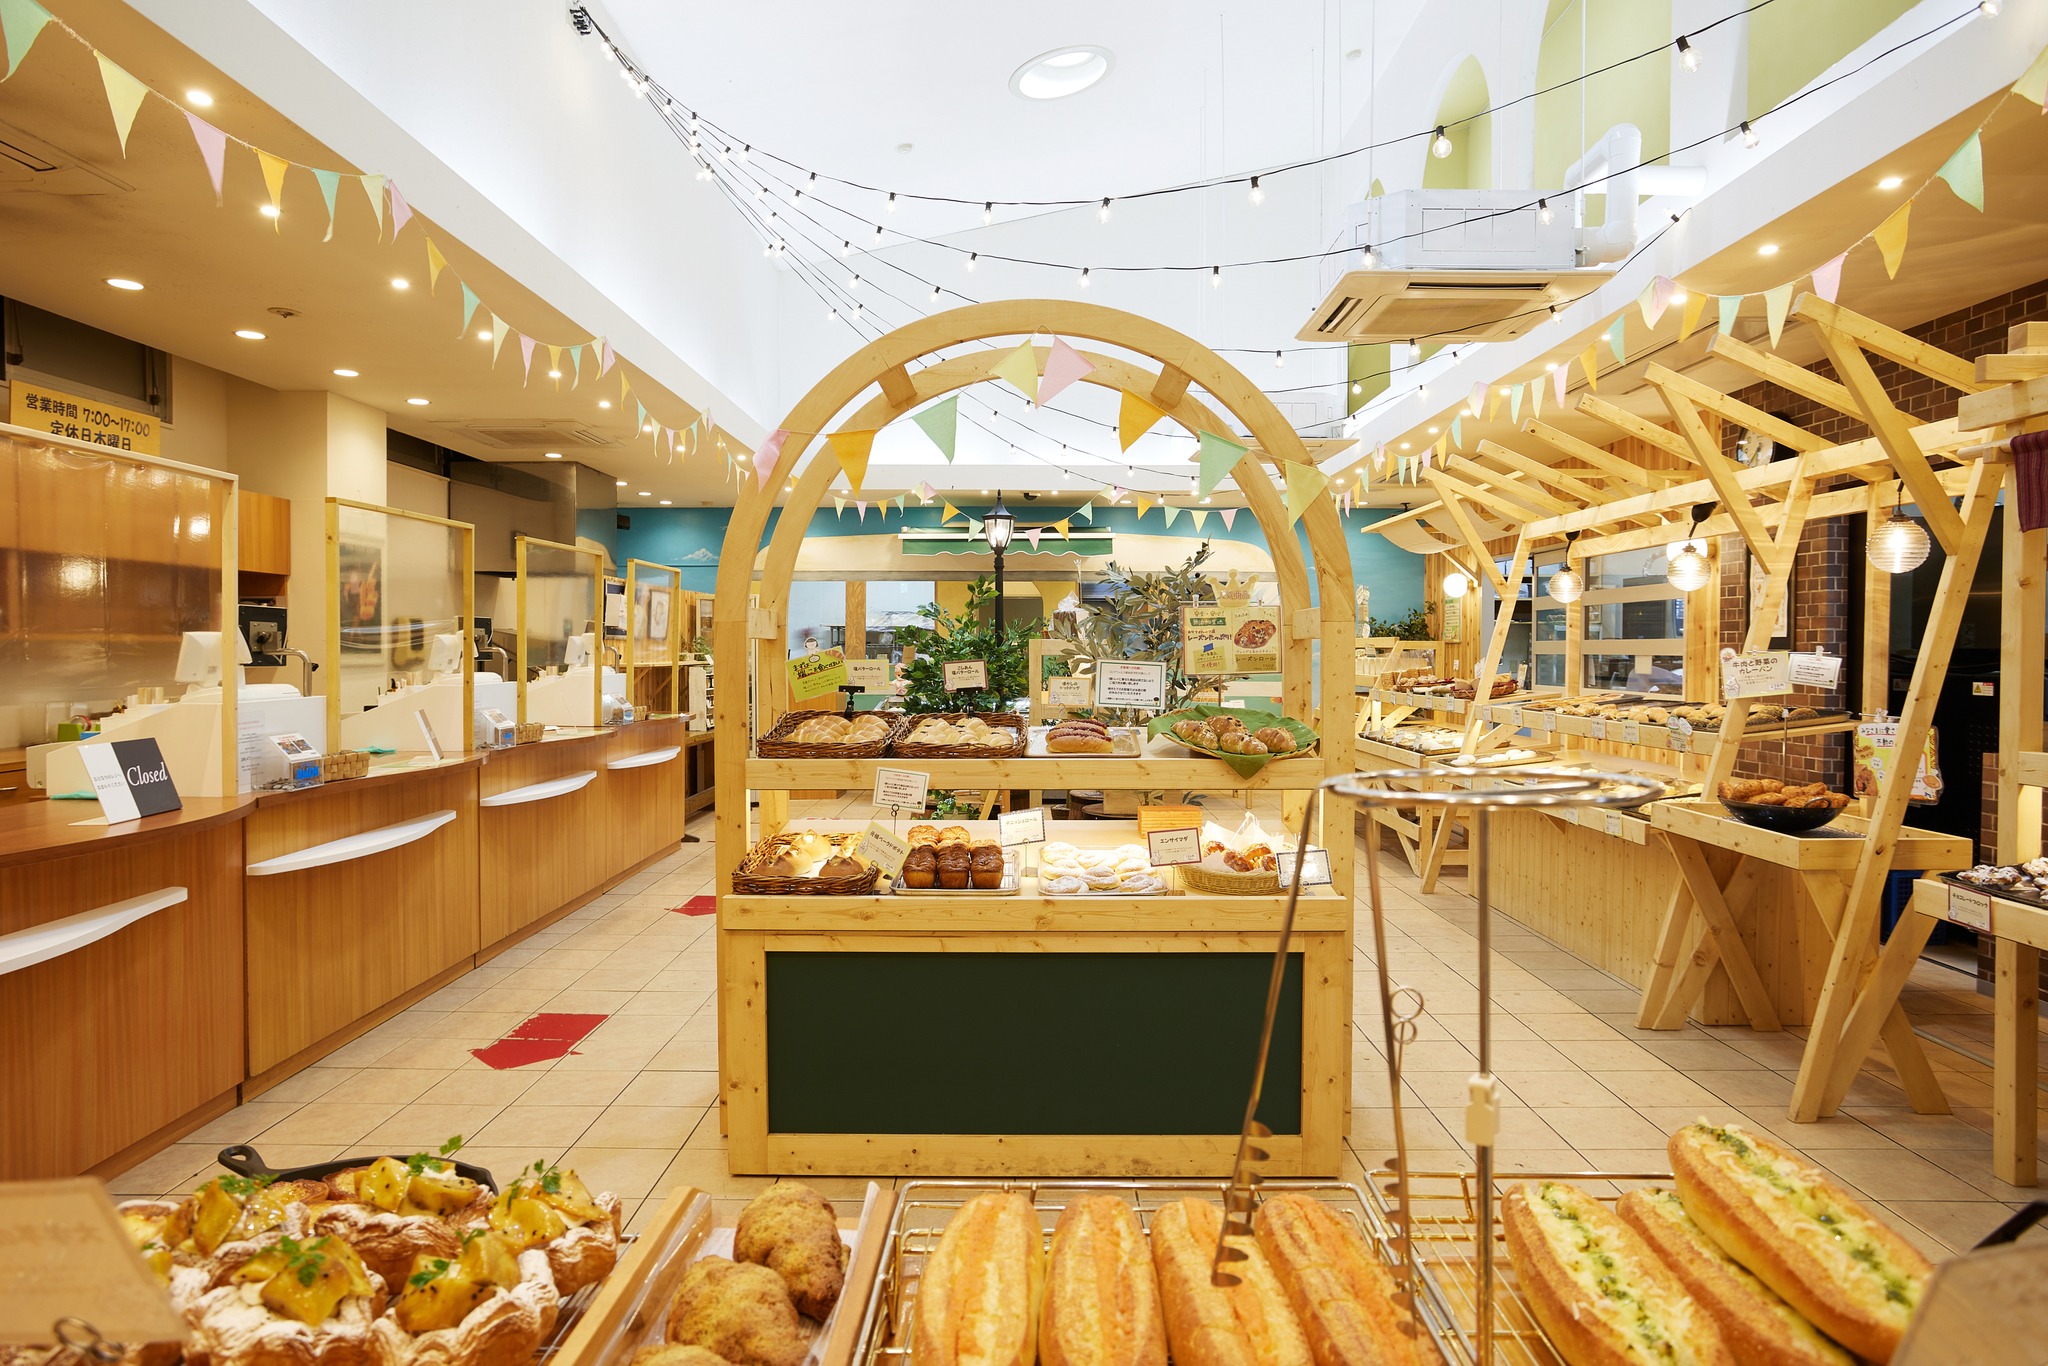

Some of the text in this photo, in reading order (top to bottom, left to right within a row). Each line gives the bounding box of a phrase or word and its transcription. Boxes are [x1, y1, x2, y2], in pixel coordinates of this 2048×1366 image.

[25, 393, 78, 419] 営業時間
[50, 420, 132, 451] 定休日木曜日
[1732, 657, 1778, 668] 牛肉と野菜の
[1739, 665, 1773, 675] カレーパン
[126, 761, 169, 786] Closed
